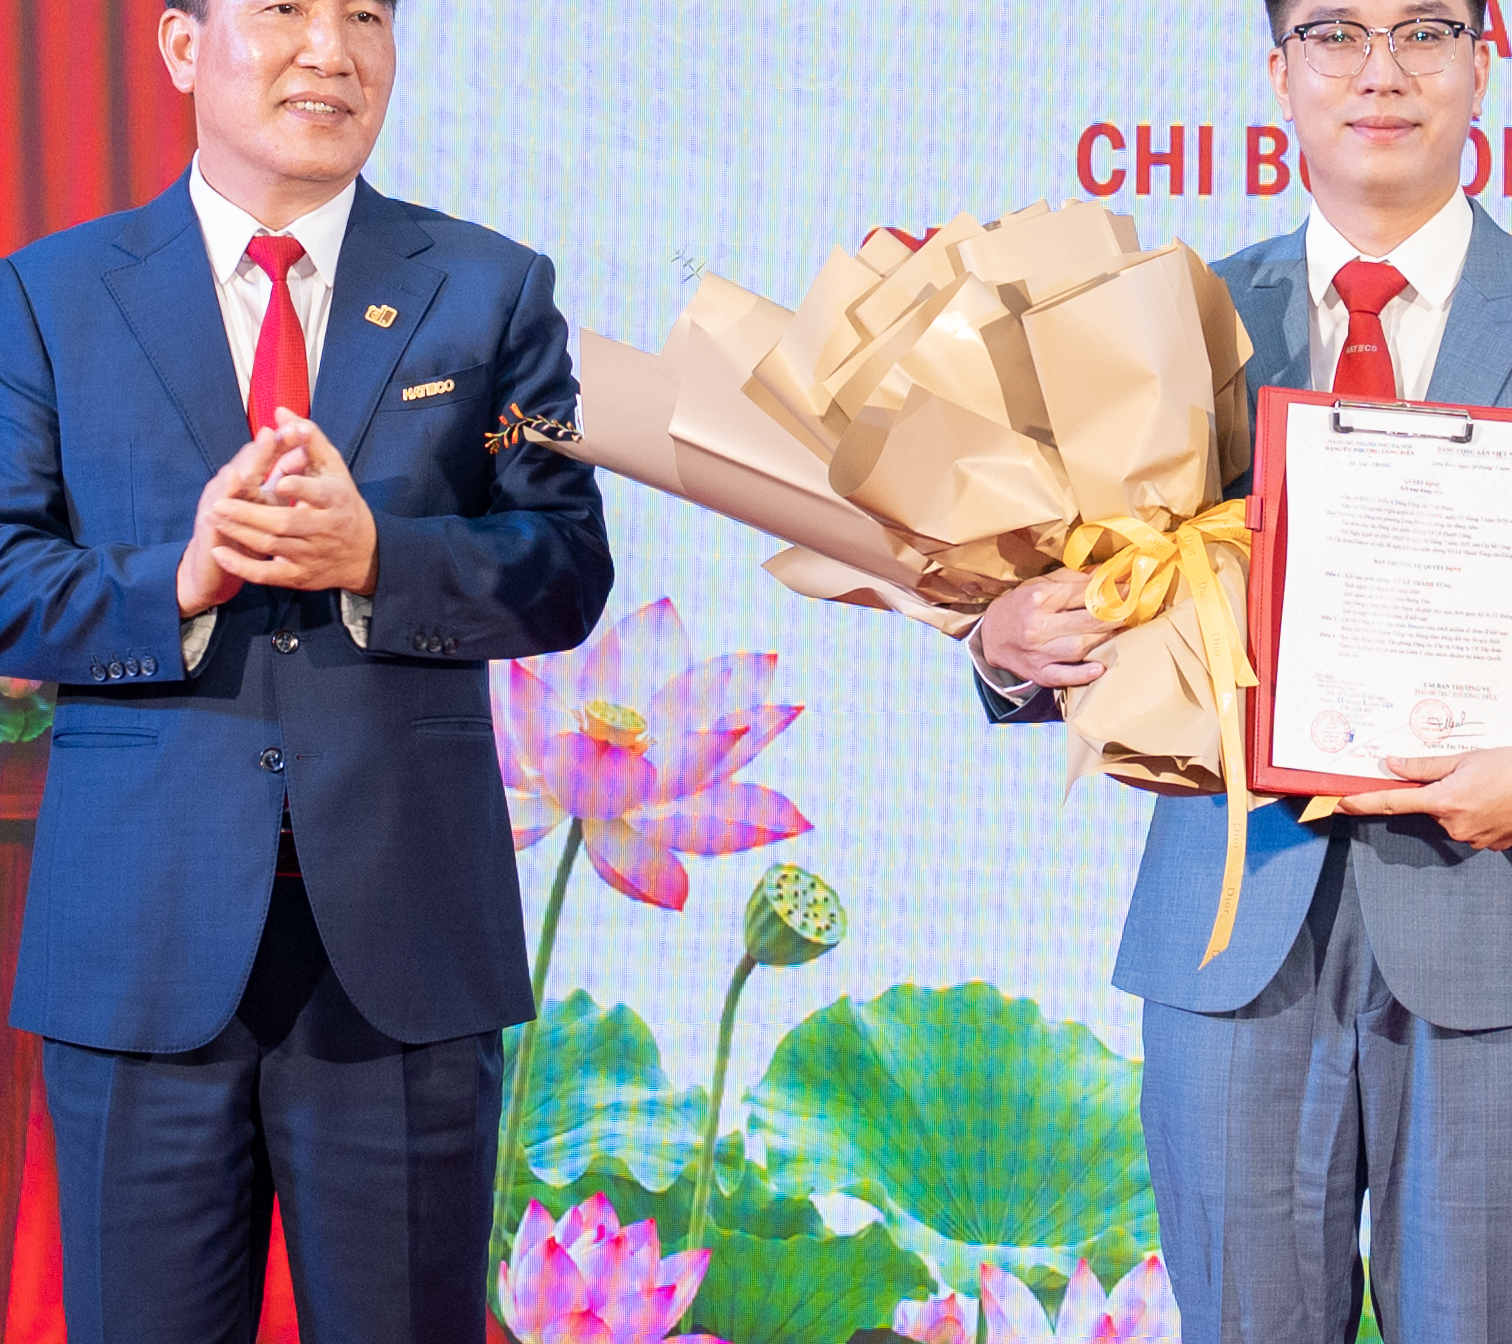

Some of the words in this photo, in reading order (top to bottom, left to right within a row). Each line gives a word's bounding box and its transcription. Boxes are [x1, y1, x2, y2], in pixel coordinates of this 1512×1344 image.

[1076, 123, 1213, 197] CHI
[1246, 125, 1312, 196] B
[1184, 534, 1197, 556] Dior
[1197, 582, 1210, 604] Dior
[1210, 632, 1221, 657] Dior
[1232, 822, 1242, 851] Dior
[1223, 887, 1236, 916] Dior
